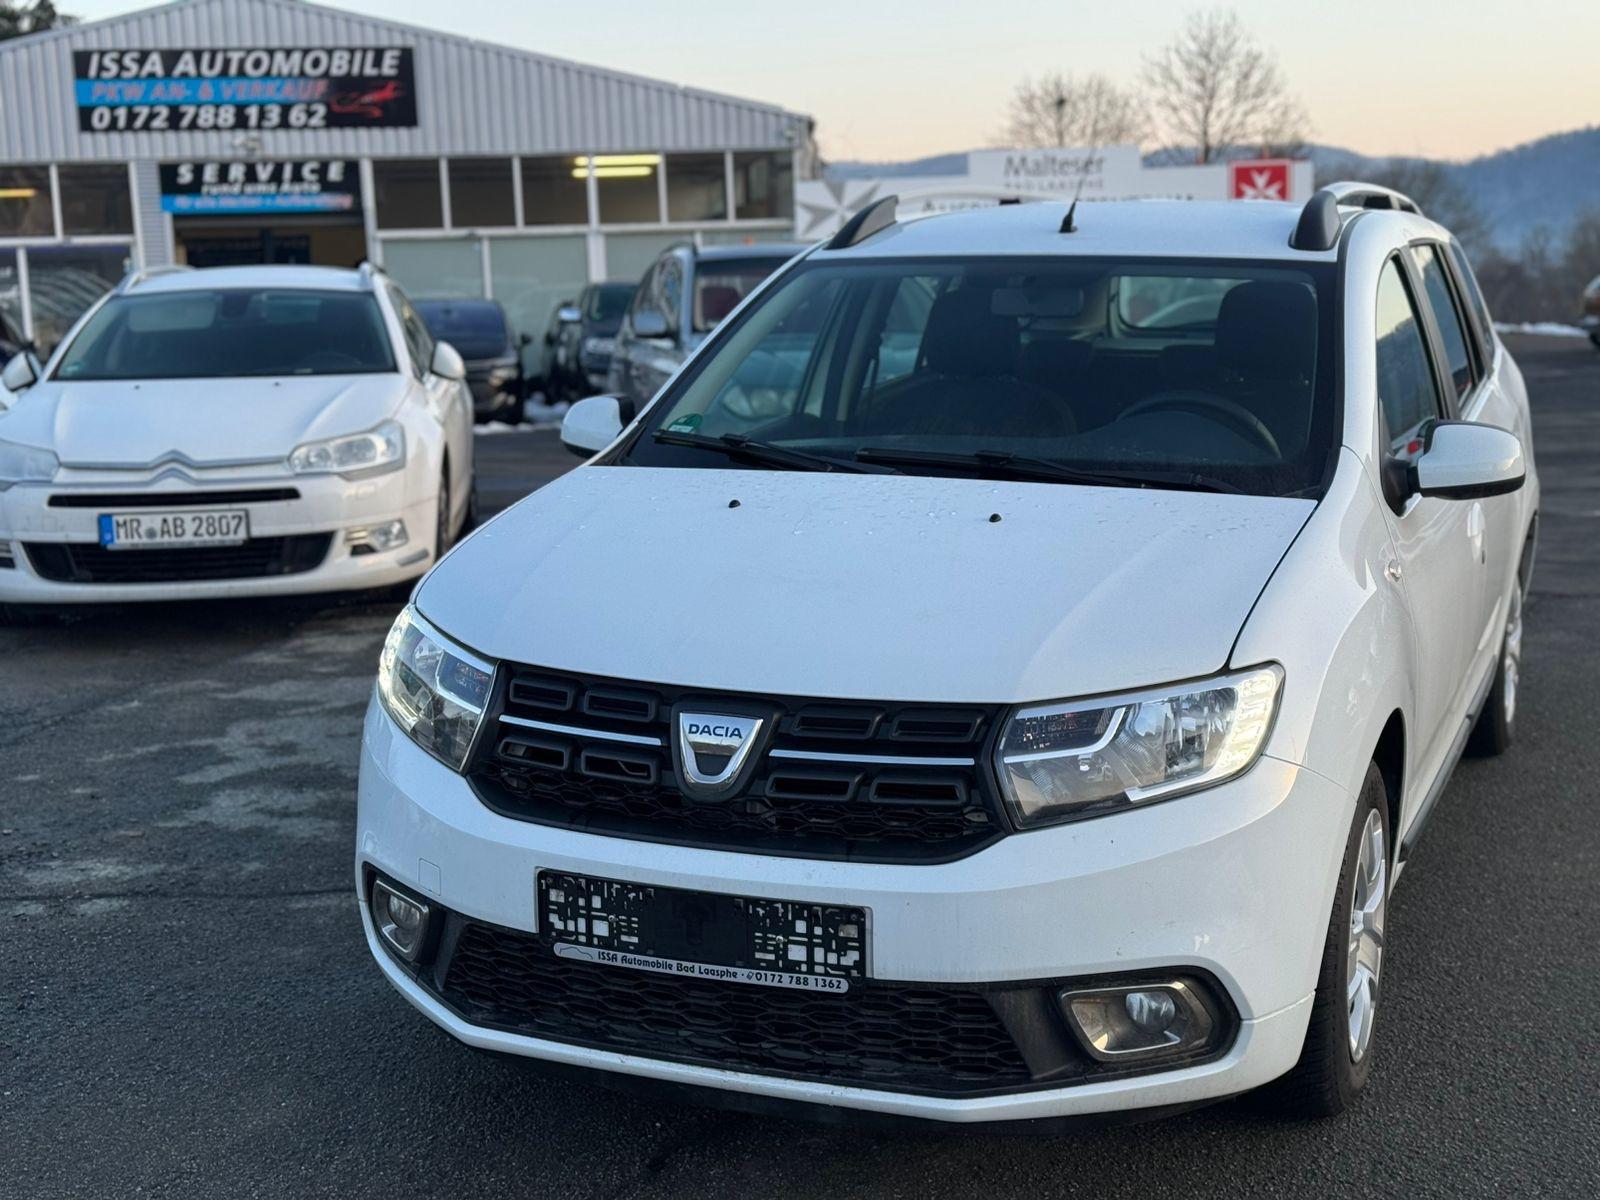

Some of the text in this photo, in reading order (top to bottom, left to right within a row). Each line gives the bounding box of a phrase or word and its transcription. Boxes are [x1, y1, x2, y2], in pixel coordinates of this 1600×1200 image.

[88, 49, 401, 78] ISSA AUTOMOBILE
[92, 81, 146, 101] PKW
[219, 78, 329, 101] VERKAUF
[90, 102, 328, 130] 0172 788 13 62
[176, 161, 346, 185] SERVICE
[1003, 153, 1105, 178] Malteser
[115, 514, 243, 540] MR AB 2807
[688, 723, 743, 740] DACIA
[597, 951, 842, 989] ISSA Automobile Bad Laasphe 0172 788 1362
